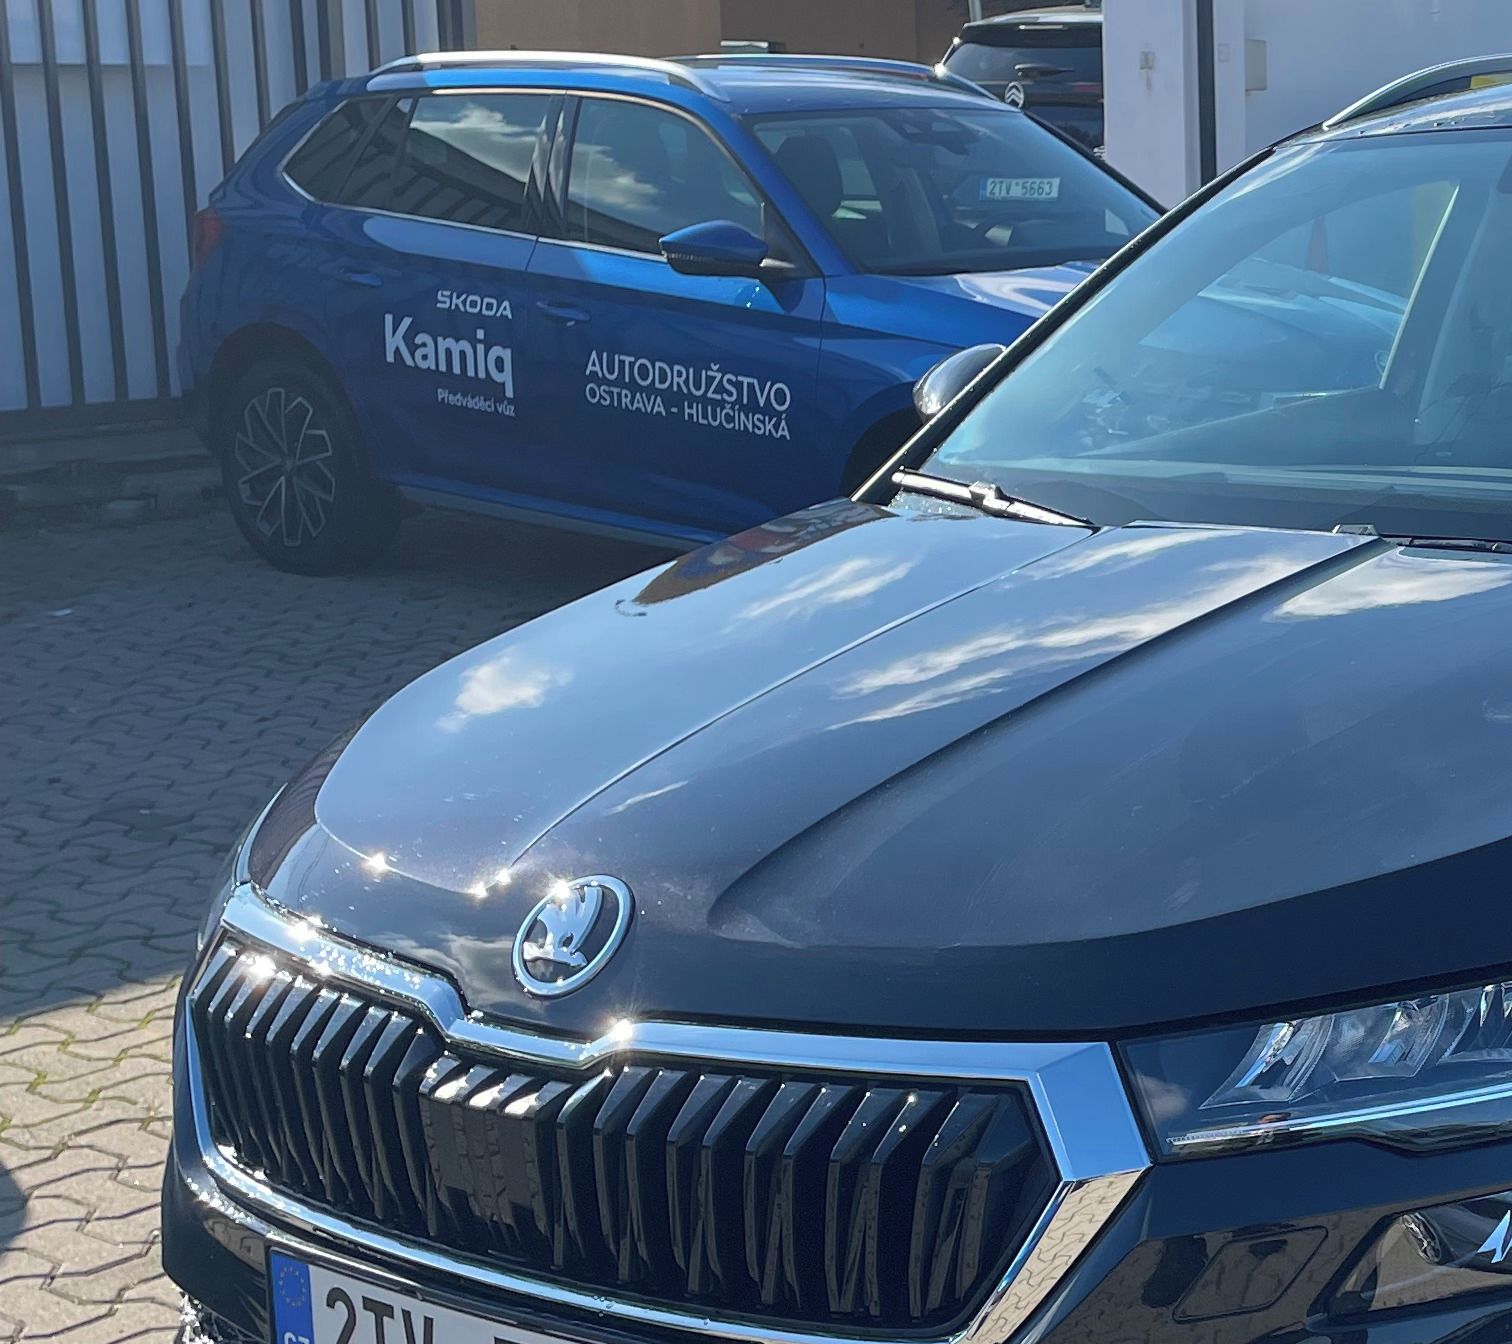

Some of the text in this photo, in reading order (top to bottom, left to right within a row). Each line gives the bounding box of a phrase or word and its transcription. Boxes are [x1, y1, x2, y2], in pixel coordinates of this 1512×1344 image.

[384, 313, 514, 399] Kamiq
[585, 350, 791, 412] AUTODRUŽSTVO
[585, 385, 666, 417] OSTRAVA
[684, 402, 791, 441] HLUČÍNSKÁ
